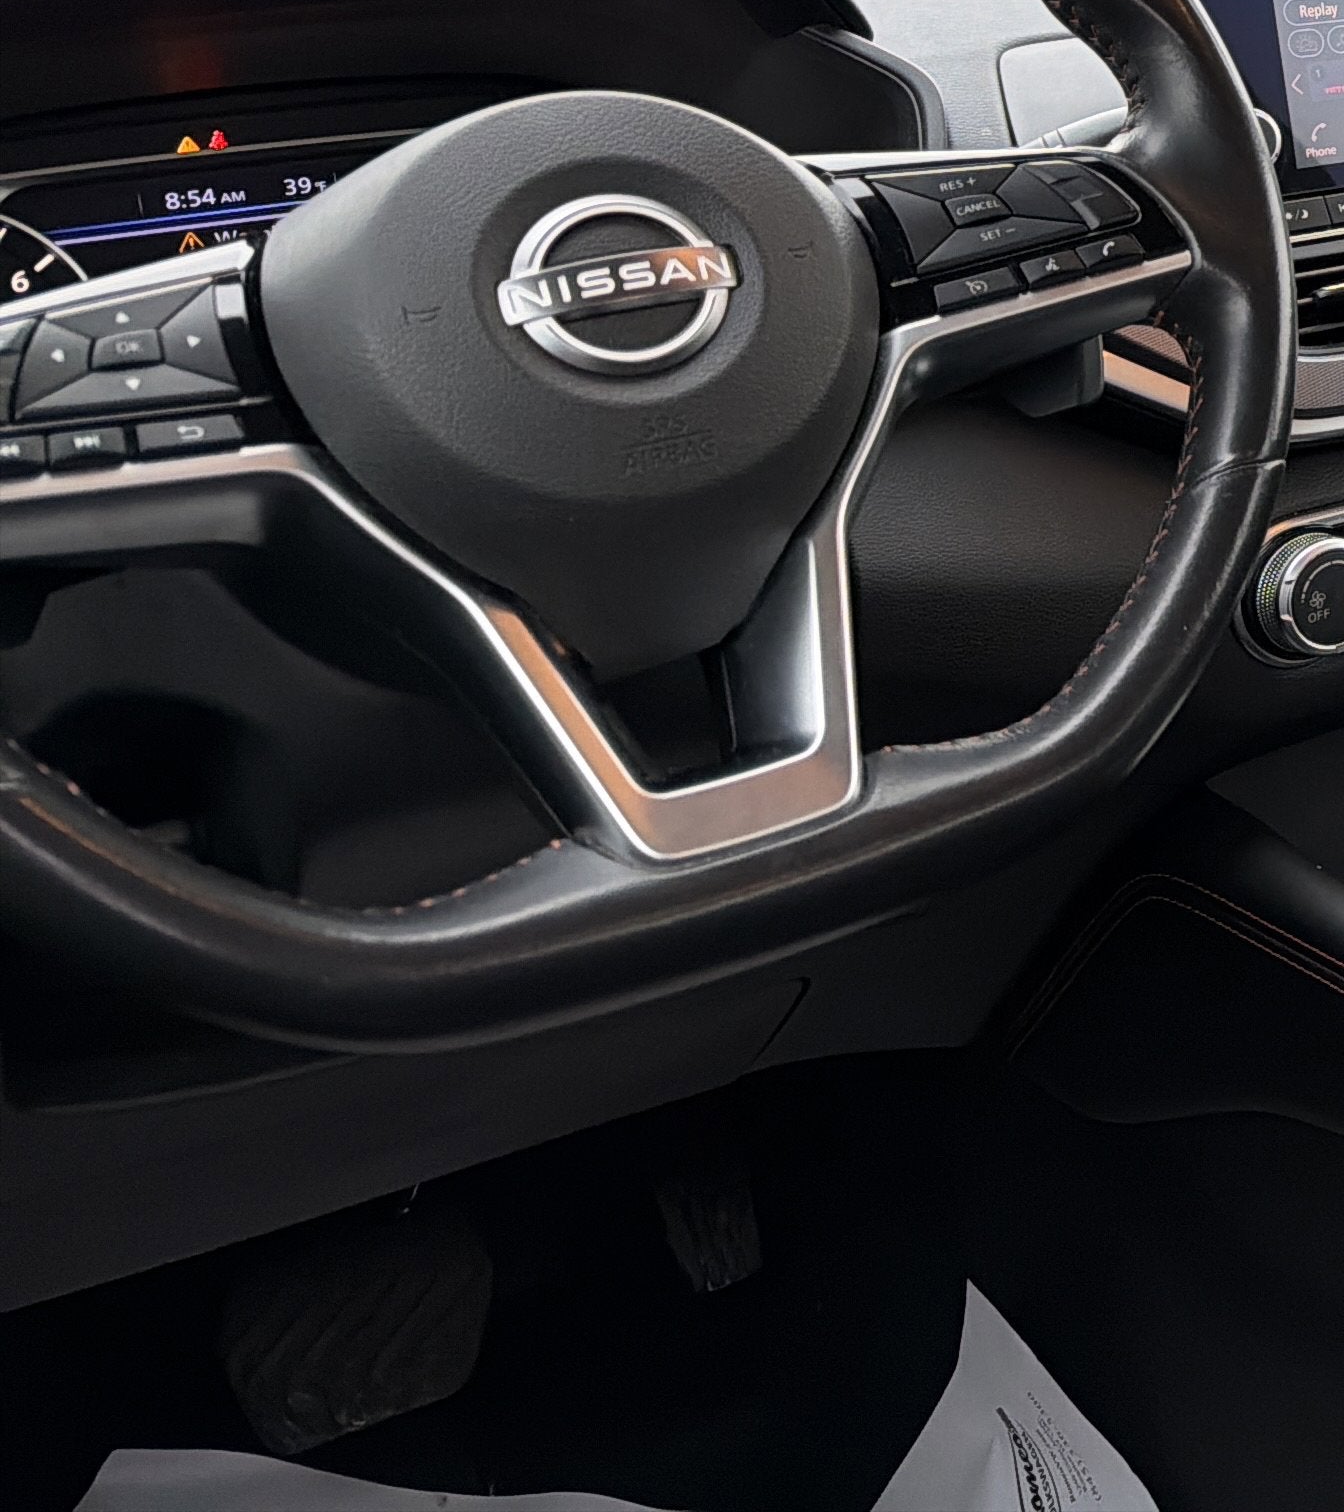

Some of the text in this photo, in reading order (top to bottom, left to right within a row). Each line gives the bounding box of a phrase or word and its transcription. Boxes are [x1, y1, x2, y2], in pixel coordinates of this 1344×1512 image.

[1299, 2, 1338, 20] Replay
[1315, 69, 1321, 79] 1
[1305, 145, 1338, 159] Phone
[282, 176, 313, 196] 39
[939, 178, 965, 194] RES
[164, 188, 247, 211] 8:54 AM
[955, 198, 1002, 217] CANCEL
[979, 227, 1003, 242] SET
[10, 270, 31, 294] 6
[504, 252, 736, 318] NISSAN
[1307, 607, 1332, 624] OFF
